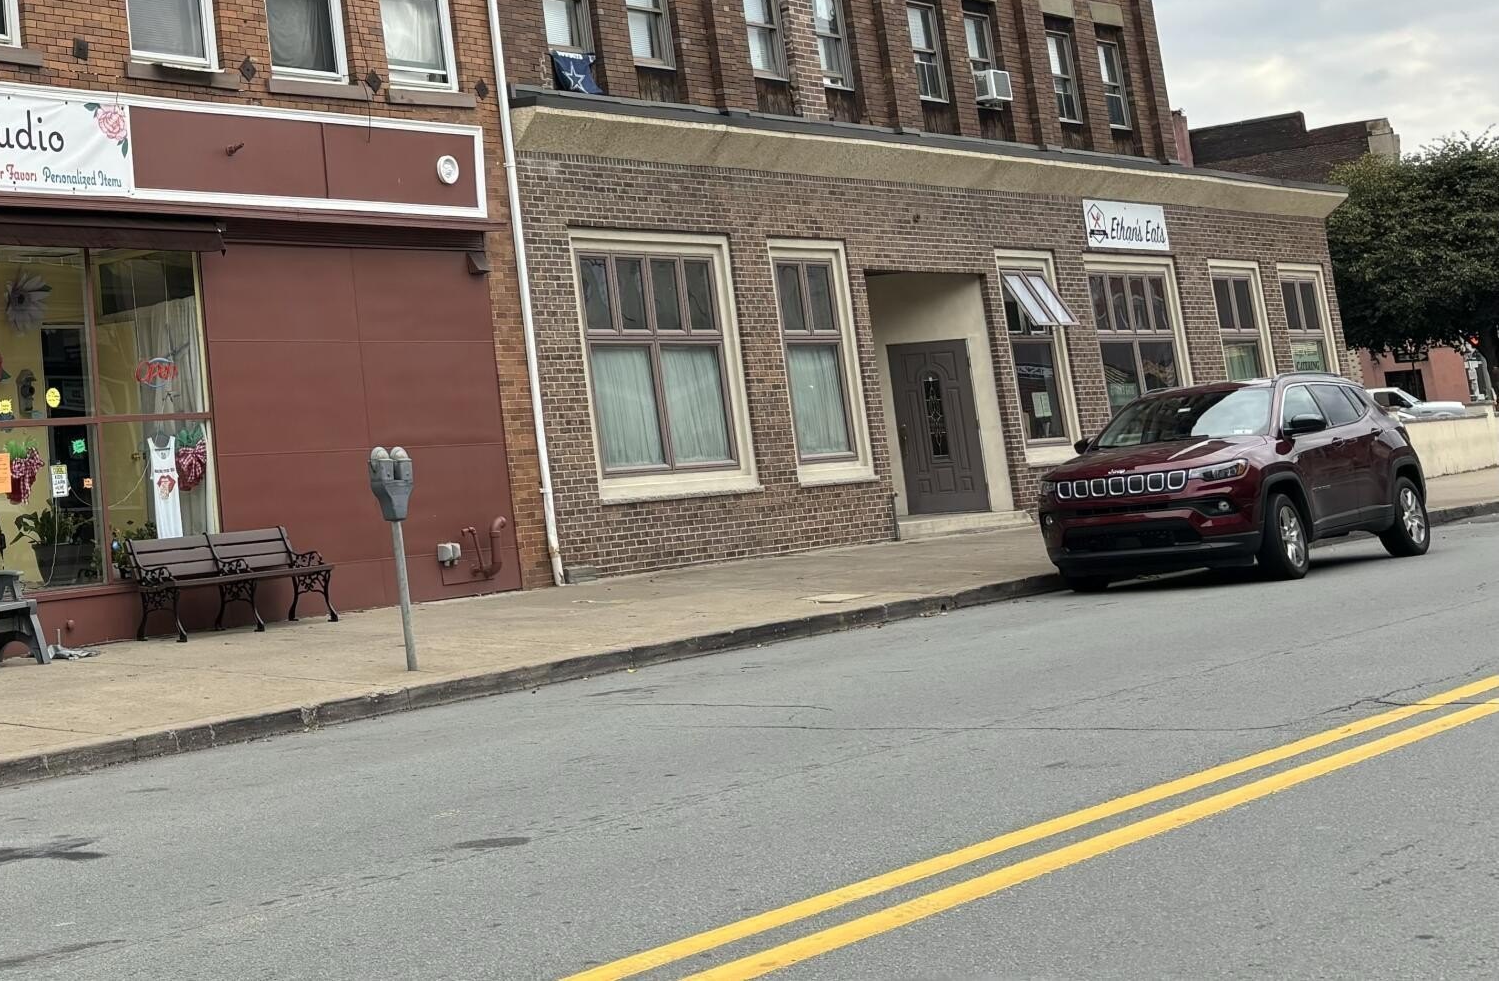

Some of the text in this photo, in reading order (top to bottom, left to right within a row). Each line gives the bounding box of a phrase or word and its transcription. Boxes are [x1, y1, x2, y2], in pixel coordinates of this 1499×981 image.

[6, 164, 37, 182] Favors
[42, 166, 97, 189] Personalized
[98, 170, 122, 188] Items
[1111, 216, 1166, 244] Ethan's Eats
